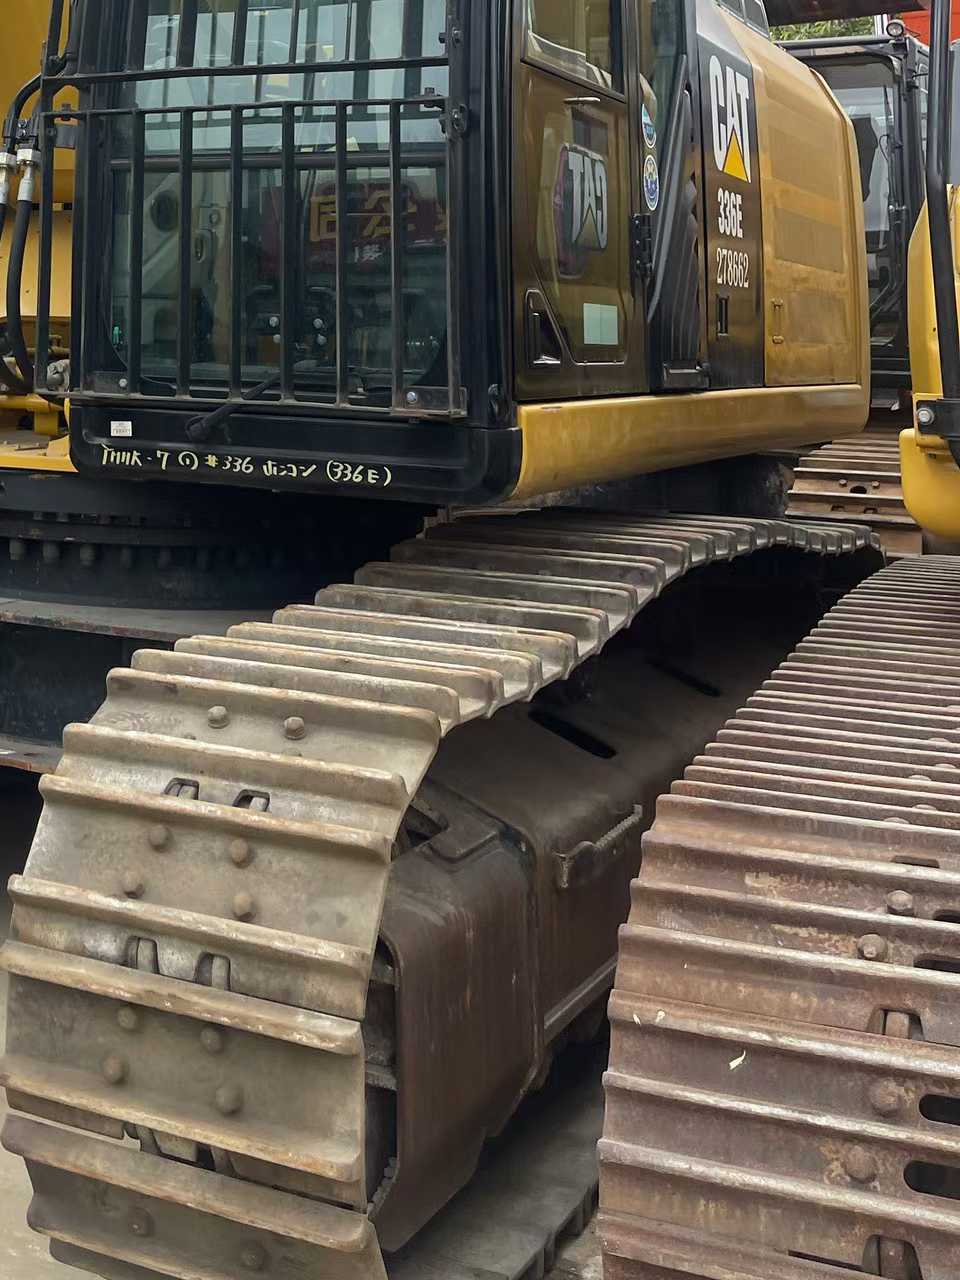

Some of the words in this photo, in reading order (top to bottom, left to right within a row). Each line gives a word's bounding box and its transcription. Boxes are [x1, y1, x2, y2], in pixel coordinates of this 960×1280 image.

[709, 55, 751, 184] CAT
[717, 187, 744, 239] 336E
[716, 247, 749, 289] 278662
